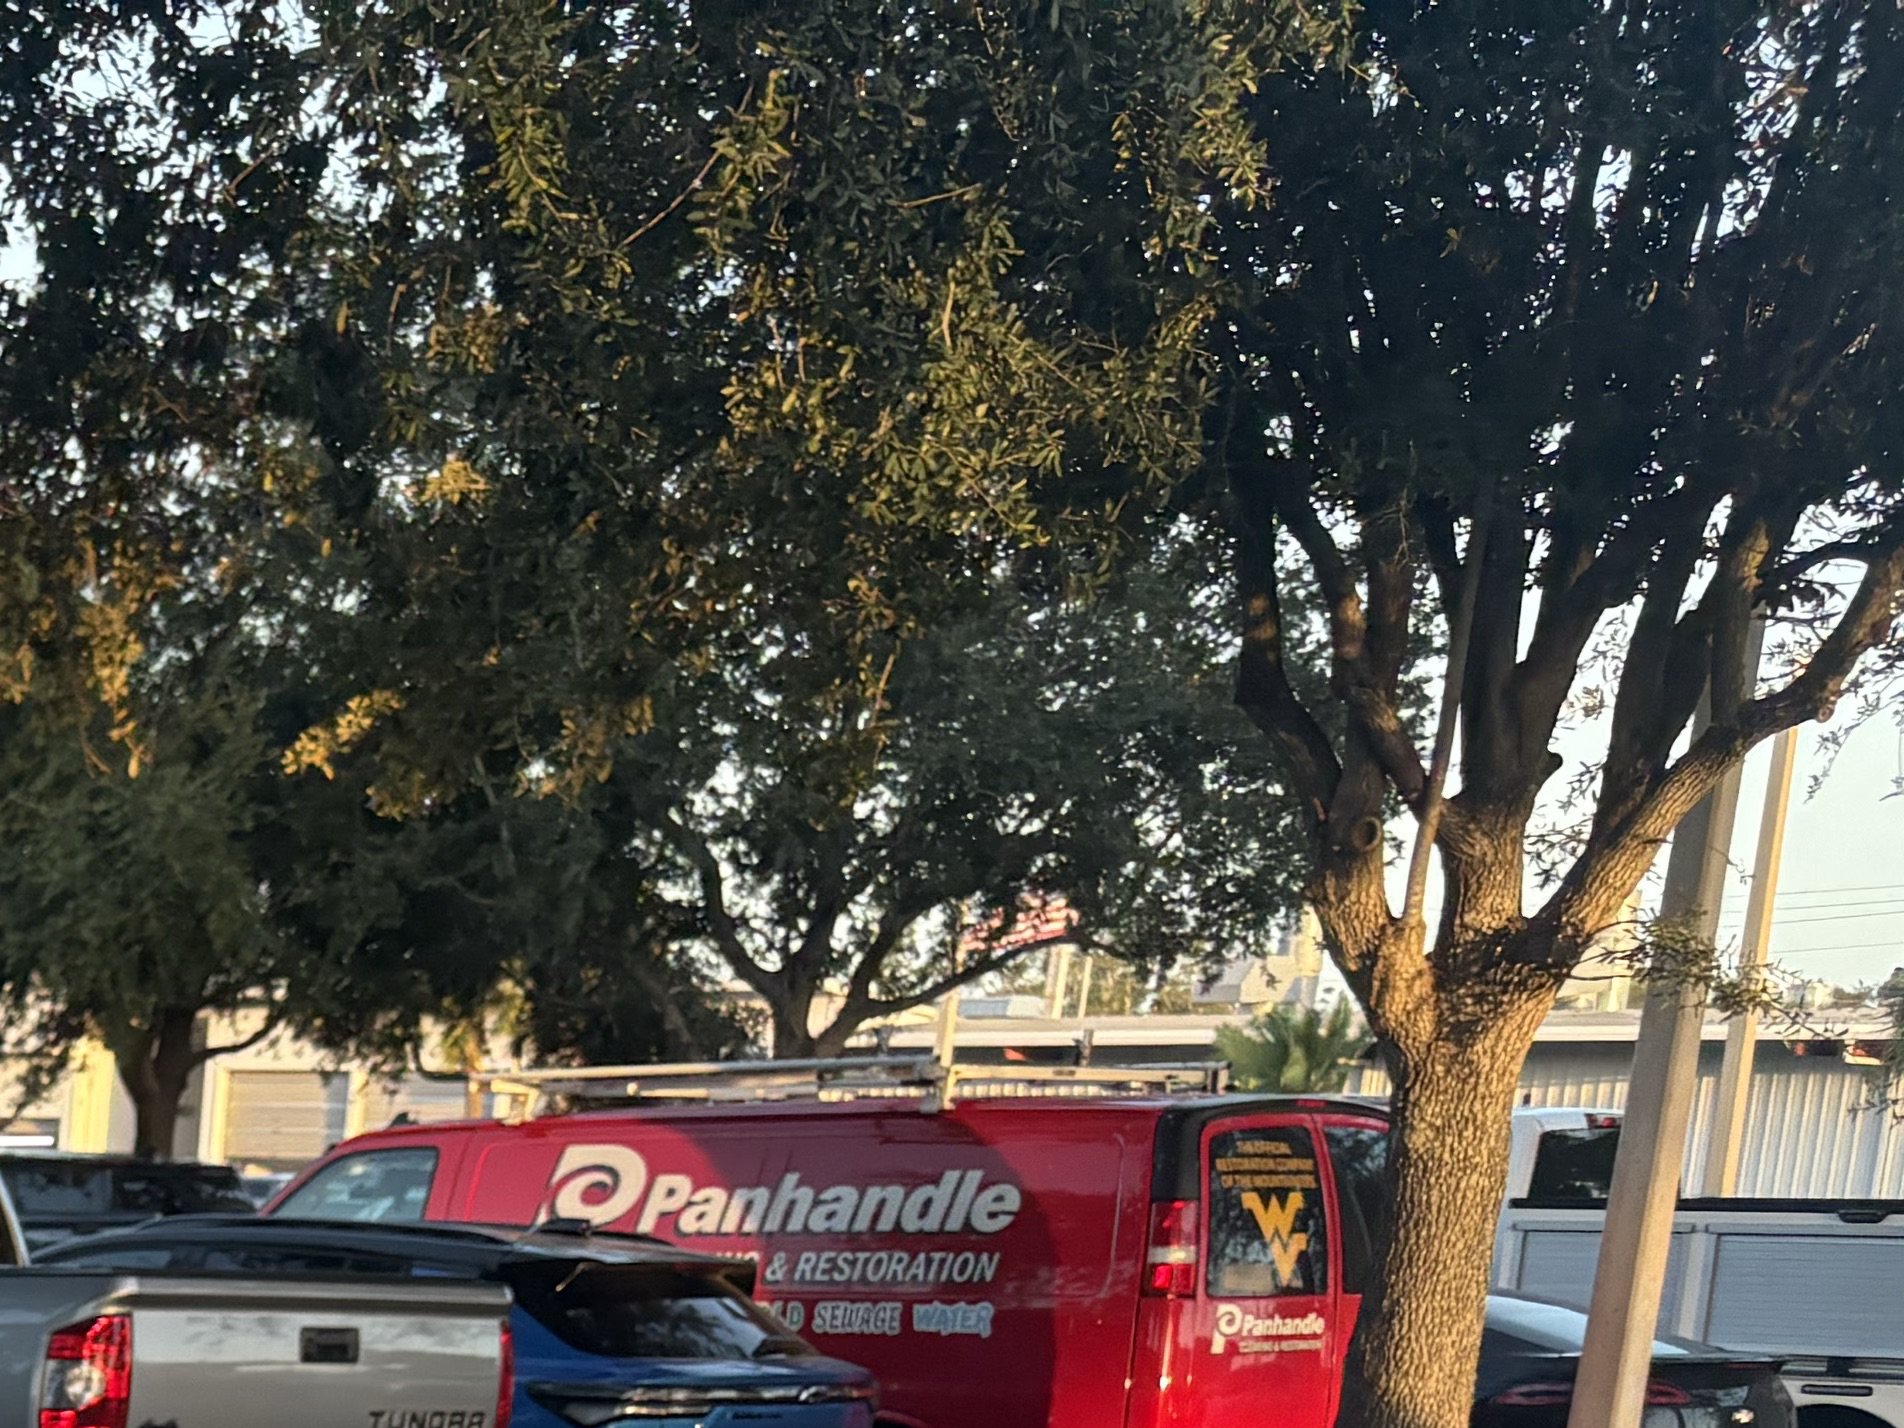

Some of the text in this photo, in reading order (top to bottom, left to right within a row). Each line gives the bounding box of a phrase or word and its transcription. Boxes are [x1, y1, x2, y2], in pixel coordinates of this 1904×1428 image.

[638, 1169, 1022, 1235] Panhandle
[764, 1251, 1000, 1283] & RESTORATION
[812, 1301, 903, 1335] SEWAGE
[913, 1300, 994, 1338] WATER
[1241, 1312, 1325, 1337] Panhandle
